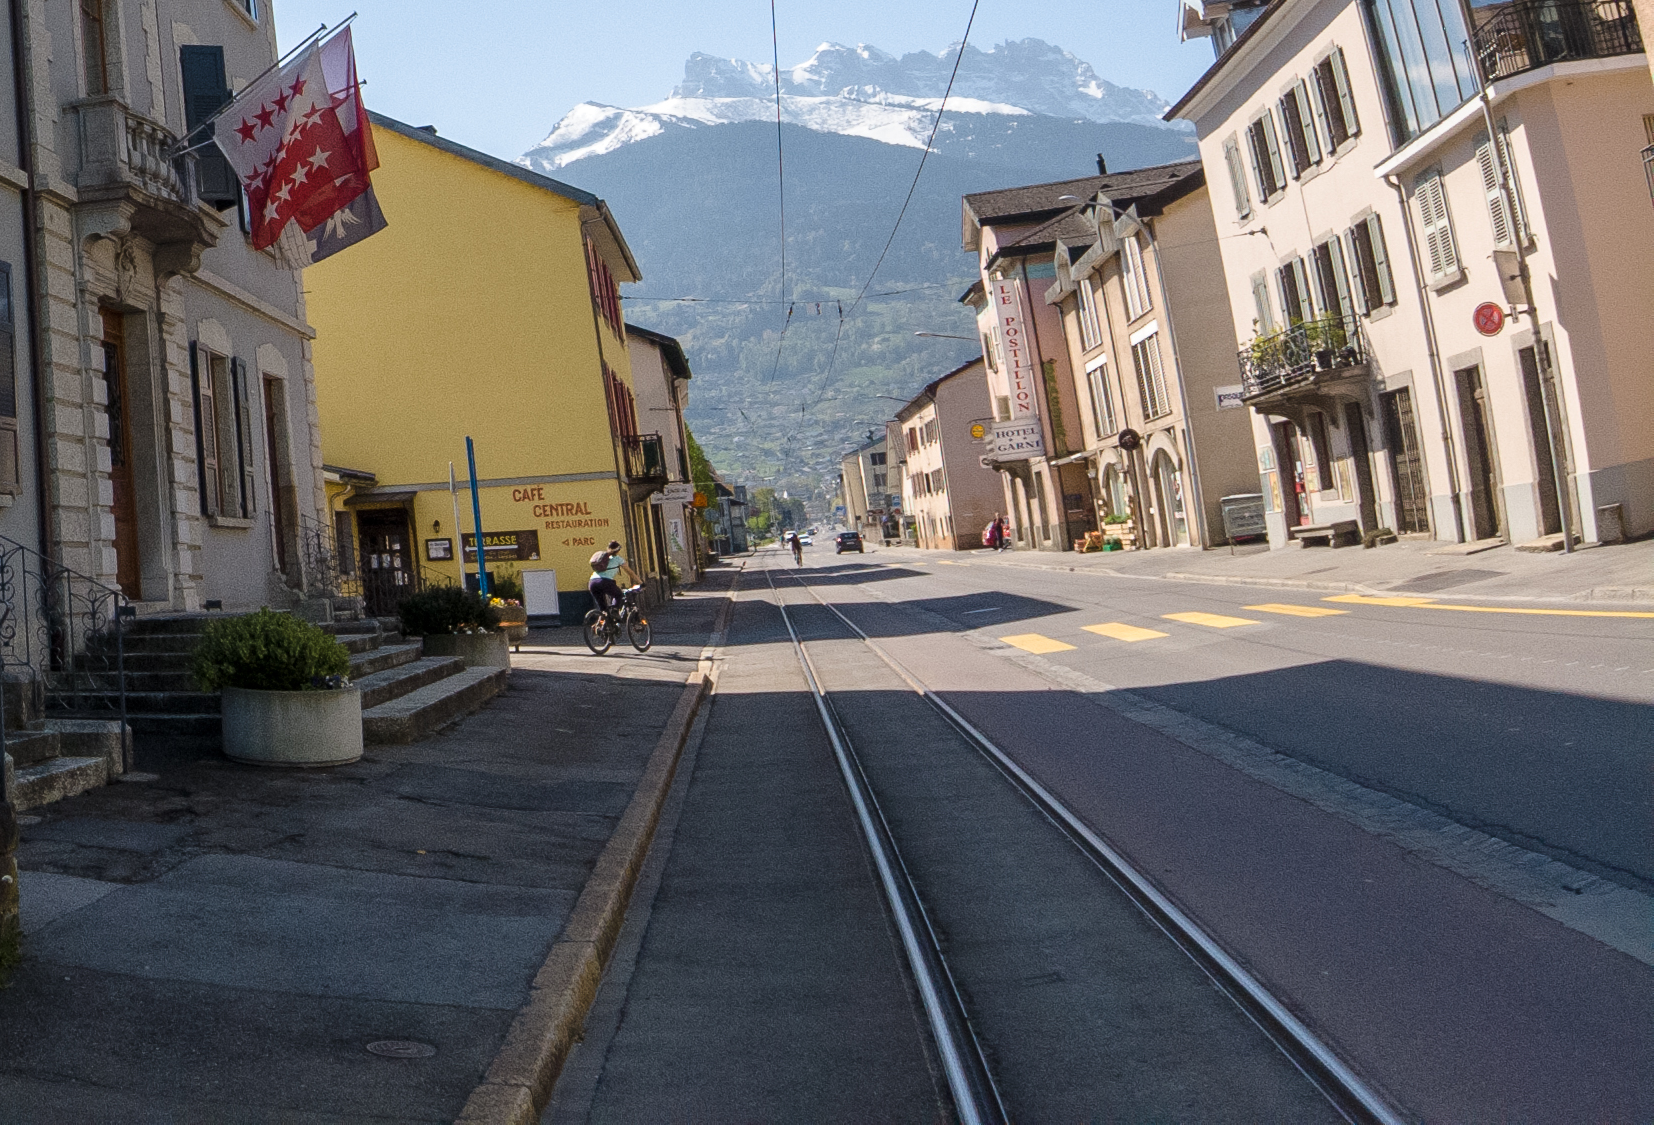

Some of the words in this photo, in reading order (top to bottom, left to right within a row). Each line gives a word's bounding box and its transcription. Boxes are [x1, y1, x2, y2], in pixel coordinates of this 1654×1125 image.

[999, 285, 1013, 306] LE
[1005, 317, 1030, 413] POSTILLON
[995, 426, 1039, 439] HOTEL
[997, 440, 1041, 453] GARNI
[533, 501, 592, 518] CENTRAL
[545, 518, 610, 530] RESTAURATION
[572, 537, 595, 547] PARC
